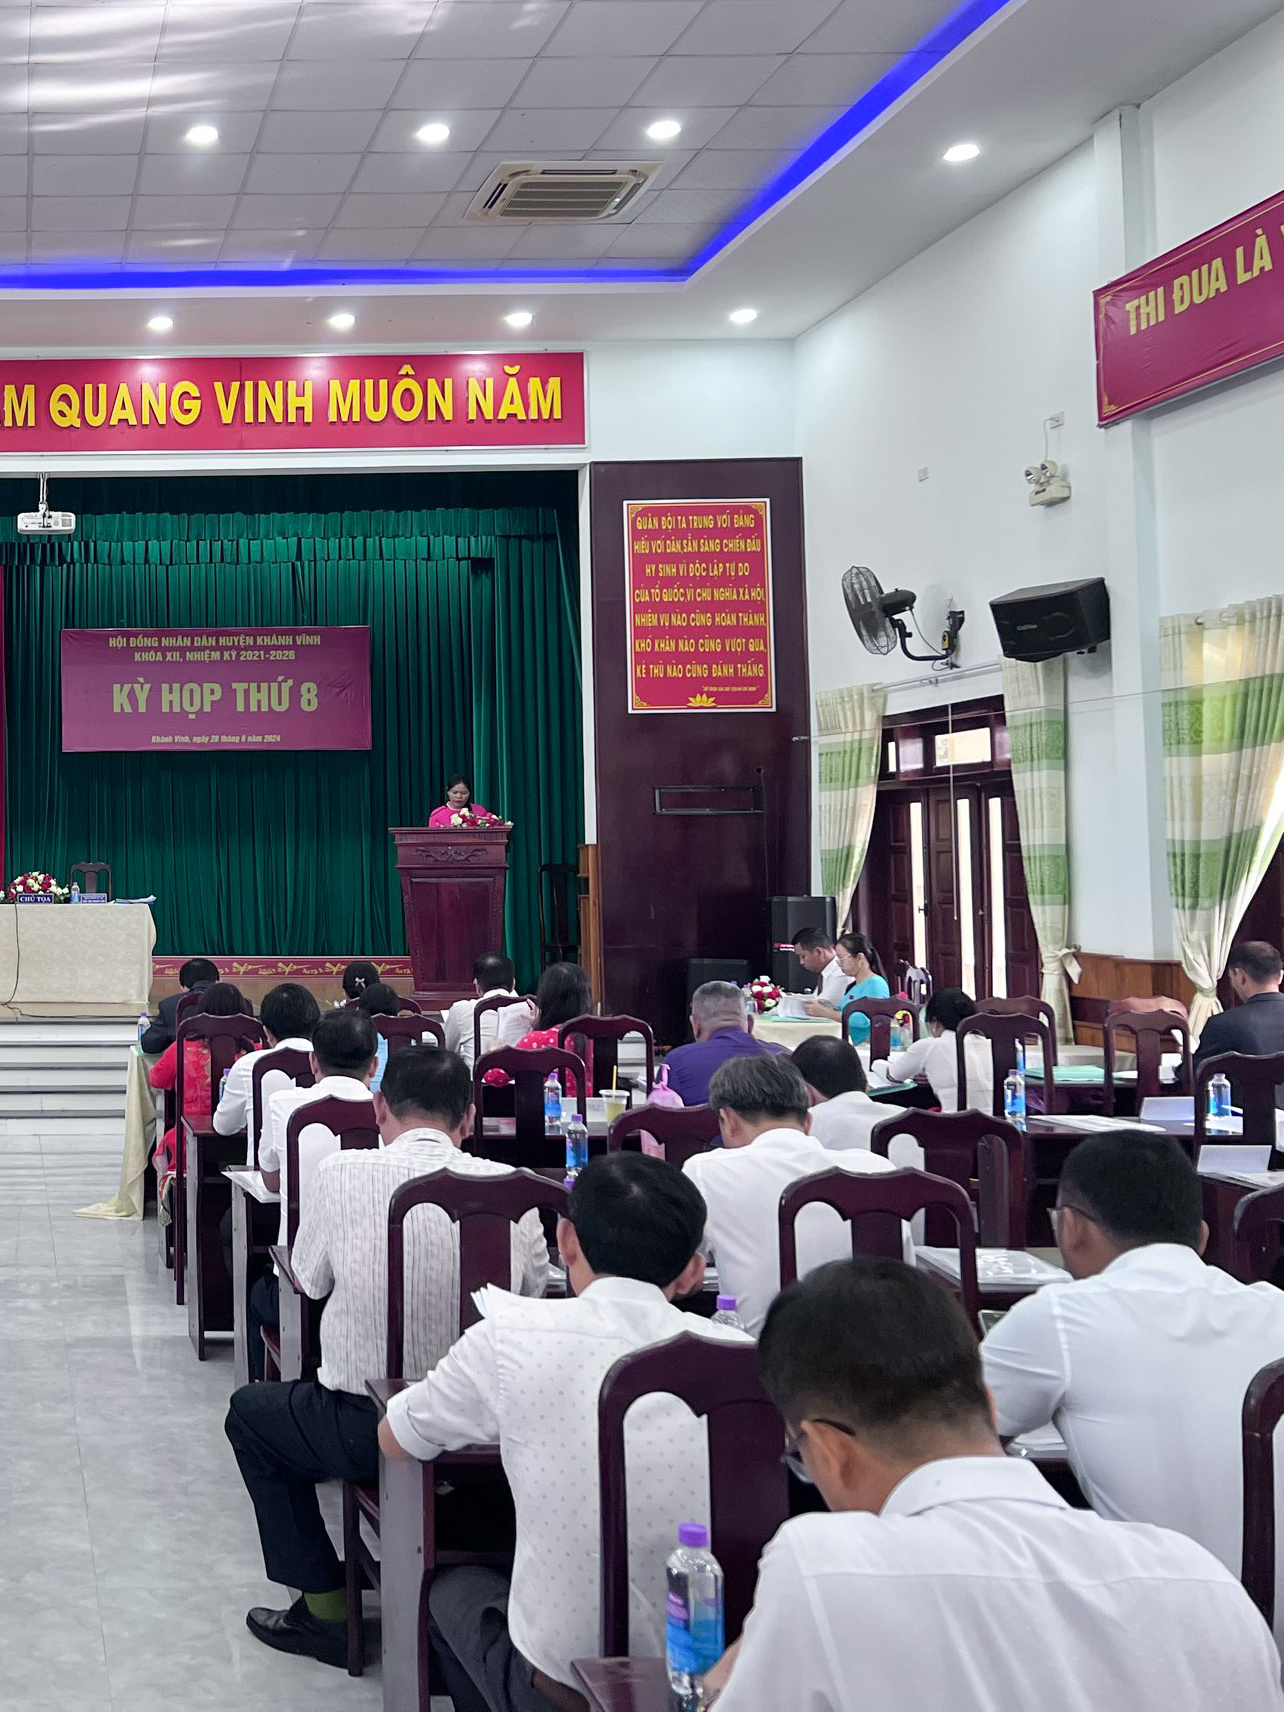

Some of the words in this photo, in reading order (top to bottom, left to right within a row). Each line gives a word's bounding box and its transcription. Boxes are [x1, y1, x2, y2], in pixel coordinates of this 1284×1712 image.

[1126, 286, 1165, 336] THI
[1172, 257, 1228, 314] ĐUA
[1236, 227, 1273, 285] LÀ
[48, 379, 201, 428] QUANG
[213, 380, 313, 424] VINH
[328, 364, 454, 423] MUÔN
[466, 364, 562, 421] NĂM
[637, 514, 658, 529] QUÂN
[662, 513, 675, 532] ĐỘI
[677, 516, 686, 529] TA
[689, 515, 714, 529] TRUNG
[717, 510, 730, 528] VỚI
[734, 510, 755, 527] ĐẢNG
[634, 536, 649, 553] HIẾU
[651, 536, 664, 553] VỚI
[700, 536, 720, 552] SÀNG
[723, 534, 745, 552] CHIẾN
[747, 533, 761, 552] ĐẤU
[645, 564, 656, 576] HY
[659, 564, 676, 576] SINH
[679, 561, 686, 576] VÌ
[689, 560, 707, 580] ĐỘC
[709, 560, 723, 579] LẬP
[726, 562, 735, 579] TỰ
[738, 563, 749, 576] DO
[635, 584, 649, 602] CỦA
[651, 581, 660, 601] TỔ
[696, 583, 711, 601] CHỦ
[714, 584, 737, 601] NGHĨA
[636, 609, 658, 629] NHIỆM
[660, 613, 669, 629] VỤ
[672, 609, 687, 626] NÀO
[690, 610, 712, 626] CŨNG
[716, 609, 737, 626] HOÀN
[109, 636, 126, 649] HỘI
[162, 635, 191, 647] NHÂN
[194, 635, 215, 647] DÂN
[219, 635, 253, 649] HUYỆN
[257, 635, 292, 646] KHÁNH
[296, 634, 320, 645] VĨNH
[636, 635, 652, 652] KHÓ
[679, 635, 695, 652] NÀO
[699, 635, 722, 652] CŨNG
[725, 637, 746, 655] VƯỢT
[134, 650, 162, 661] KHÓA
[166, 652, 183, 663] XII,
[186, 650, 220, 663] NHIỆM
[239, 650, 295, 661] 2021-2026
[637, 660, 646, 677] KẺ
[649, 660, 664, 677] THÙ
[667, 660, 683, 677] NÀO
[686, 661, 708, 677] CŨNG
[712, 660, 734, 677] ĐÁNH
[112, 677, 151, 713] KỲ
[161, 682, 222, 719] HỌP
[231, 676, 294, 712] THỨ
[300, 682, 318, 712] 8
[20, 894, 35, 902] CHỦ
